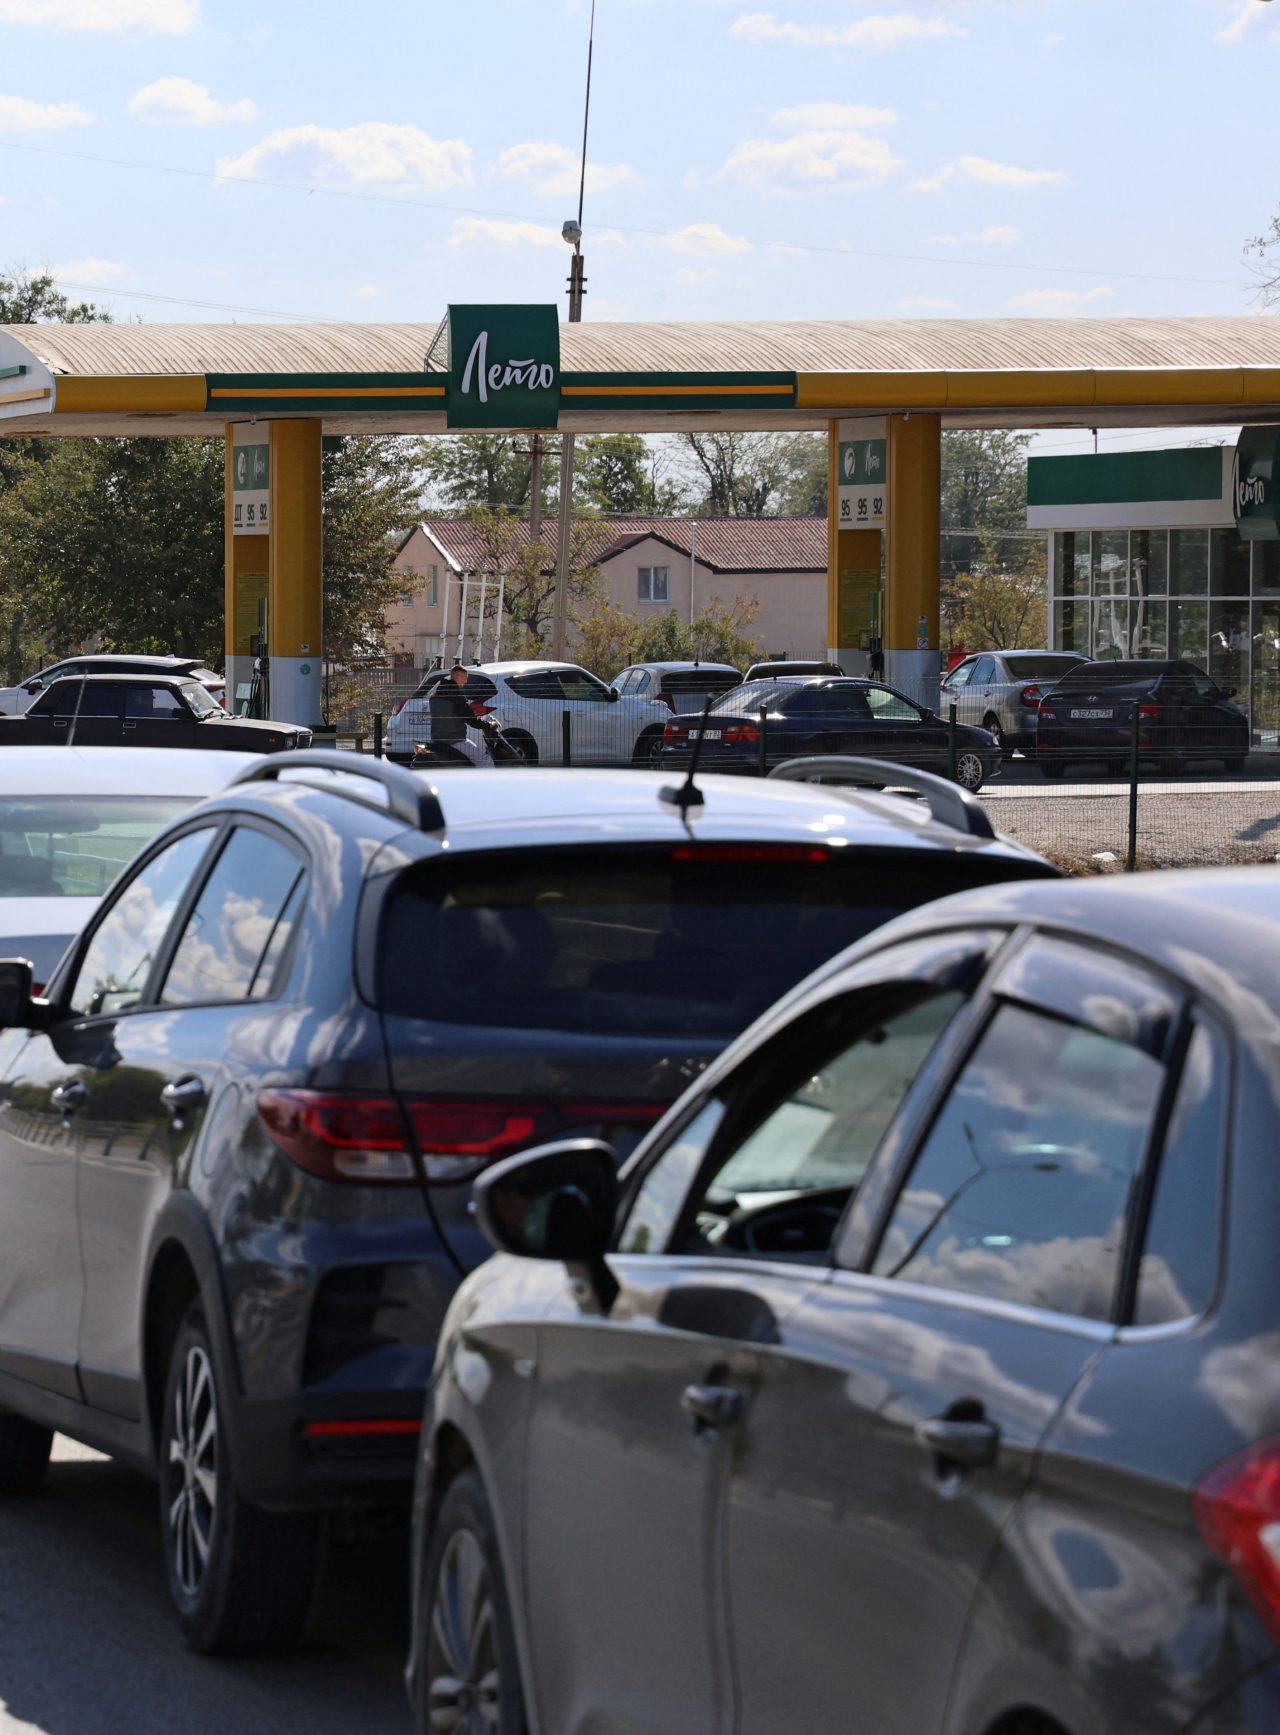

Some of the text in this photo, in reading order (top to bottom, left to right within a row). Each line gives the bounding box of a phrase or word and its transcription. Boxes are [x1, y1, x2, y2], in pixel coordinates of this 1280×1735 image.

[461, 331, 554, 403] Лето
[848, 452, 855, 479] 2
[1232, 451, 1265, 518] Лето
[247, 504, 255, 521] 95
[260, 503, 267, 520] 92
[841, 497, 883, 517] 95 95 92
